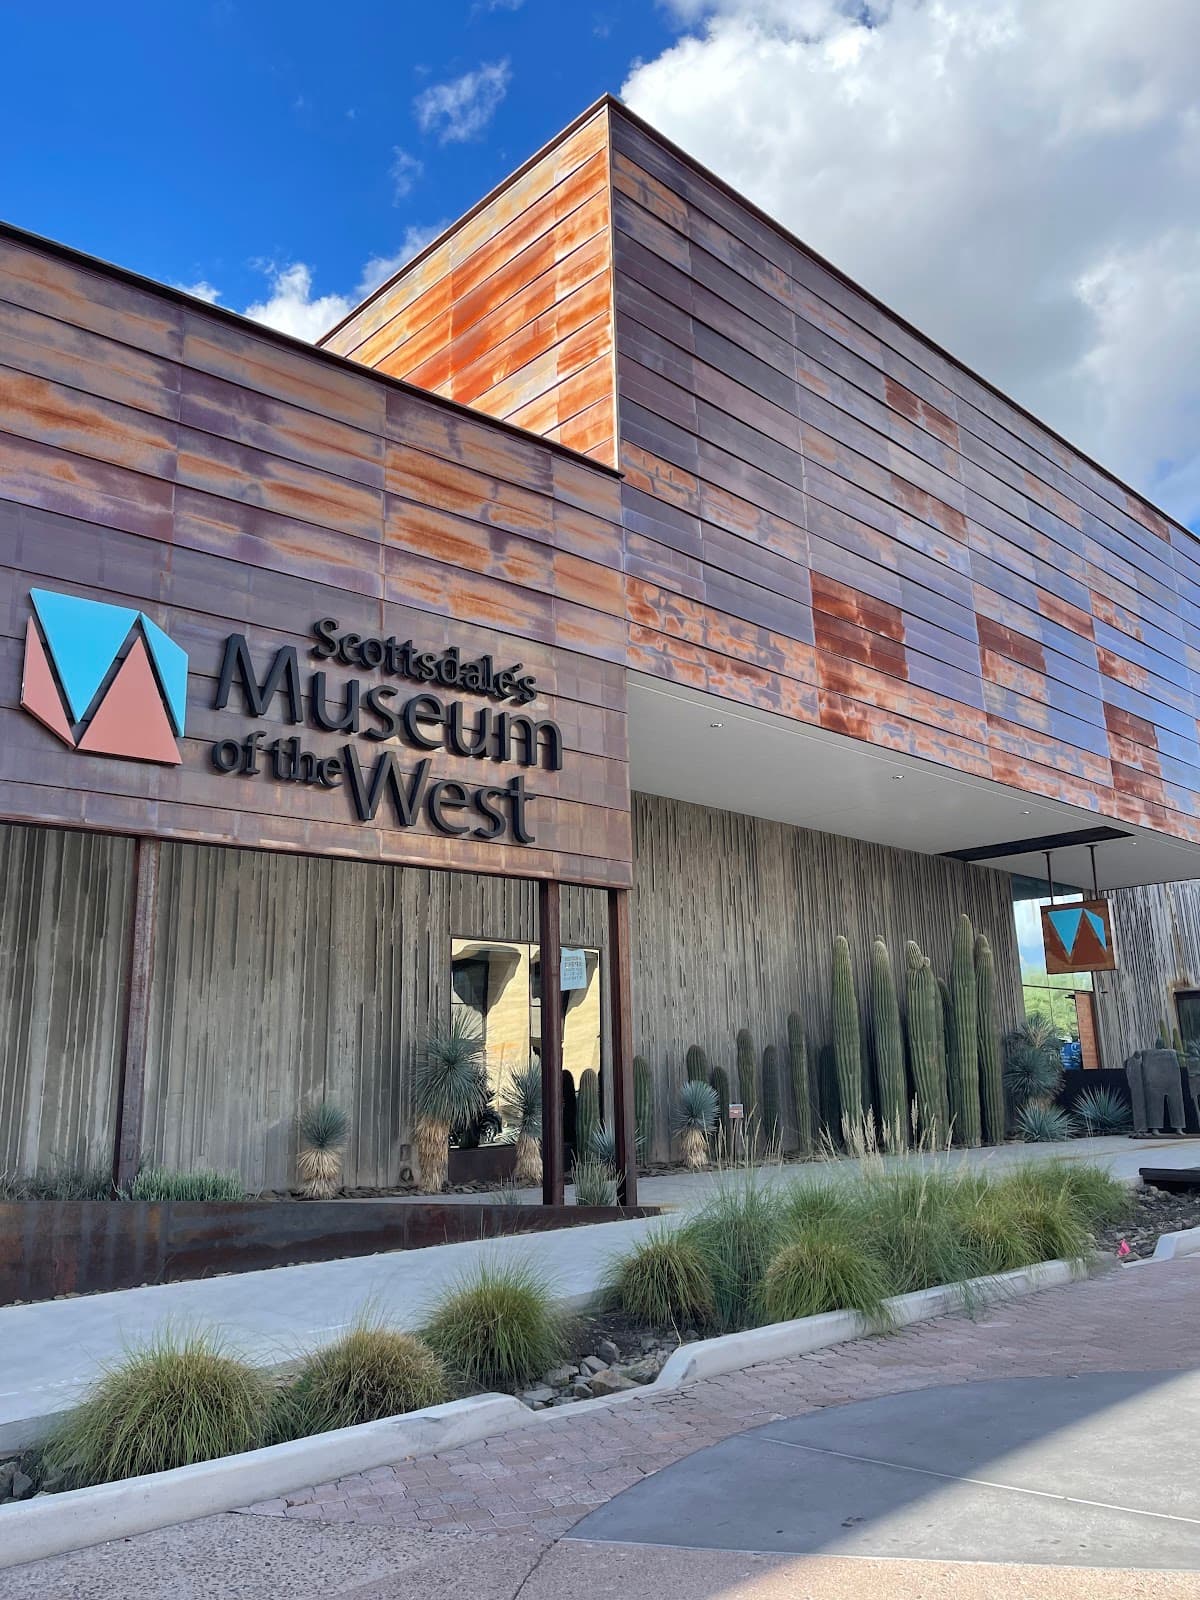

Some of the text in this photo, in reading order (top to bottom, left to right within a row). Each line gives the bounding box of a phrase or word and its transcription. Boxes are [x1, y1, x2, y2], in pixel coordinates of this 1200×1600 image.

[215, 632, 563, 771] Museum
[312, 617, 537, 703] Scottsdale's
[213, 731, 536, 844] of the West
